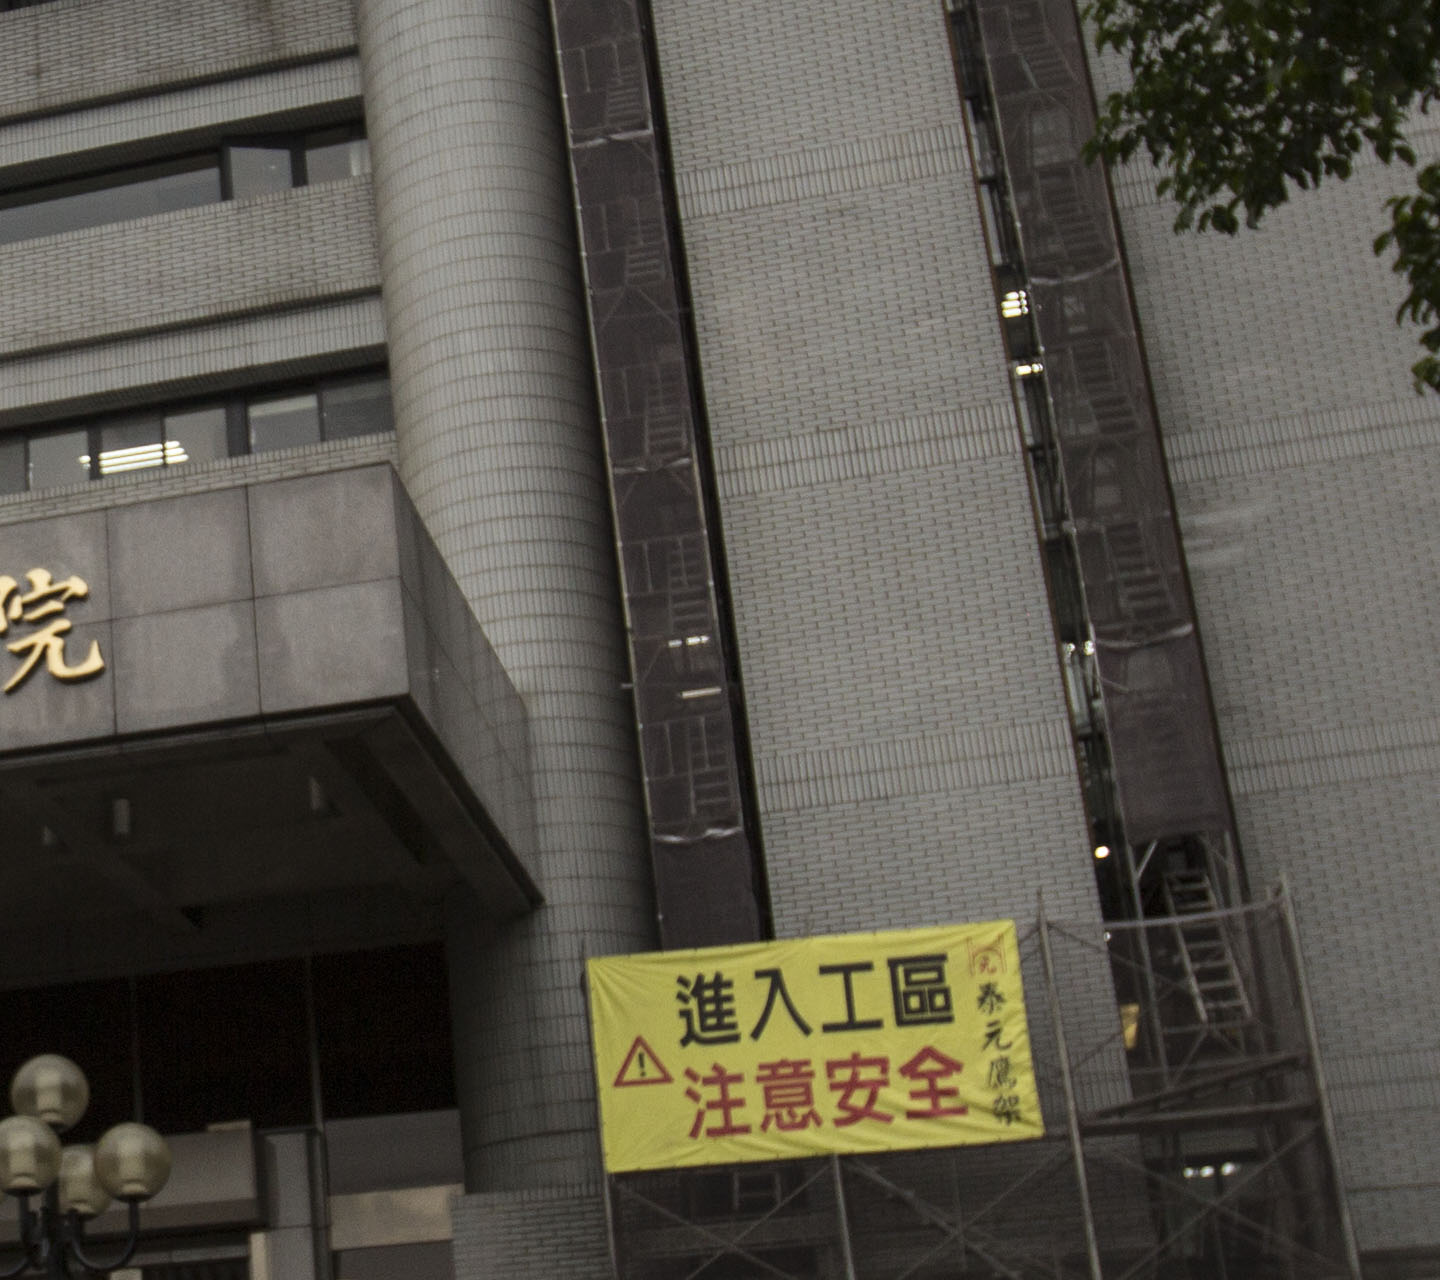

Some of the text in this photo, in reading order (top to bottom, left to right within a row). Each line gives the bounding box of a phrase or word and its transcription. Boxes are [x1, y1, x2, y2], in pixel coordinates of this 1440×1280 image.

[675, 952, 956, 1048] 進入工區
[683, 1045, 969, 1140] 注意安全
